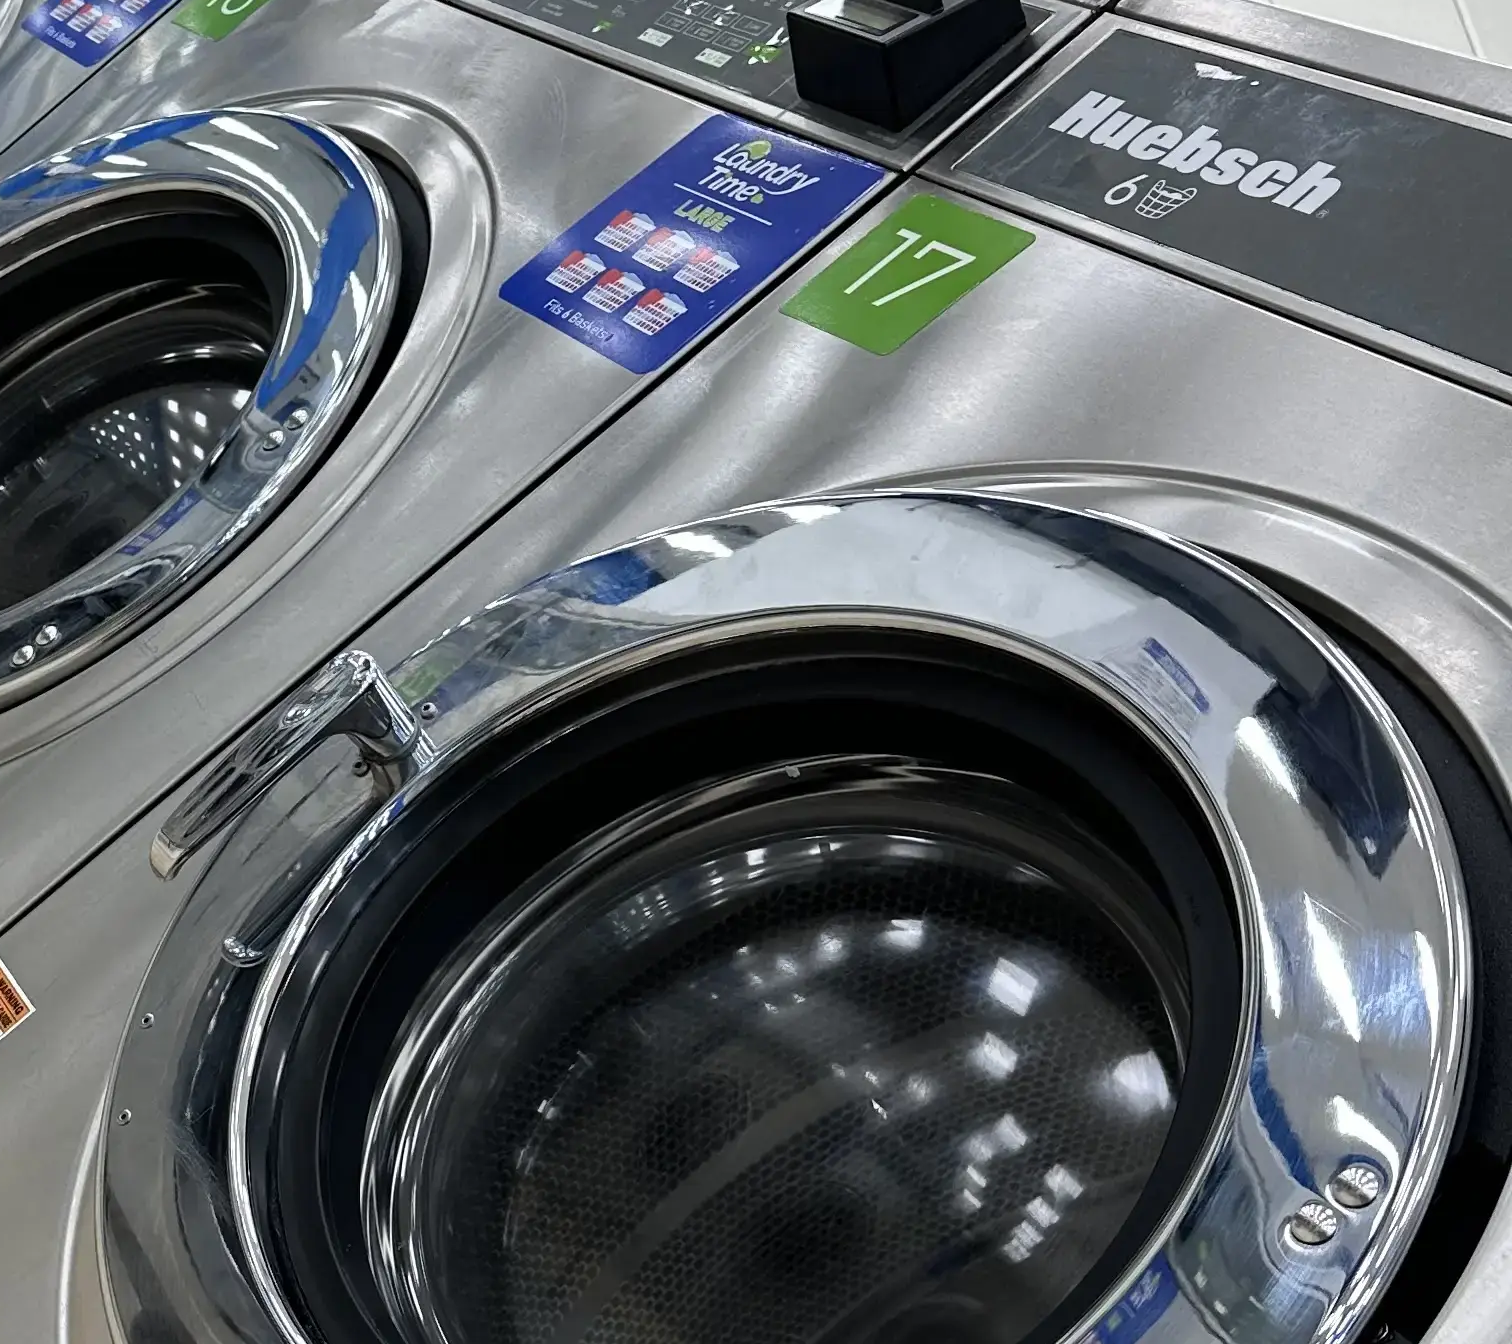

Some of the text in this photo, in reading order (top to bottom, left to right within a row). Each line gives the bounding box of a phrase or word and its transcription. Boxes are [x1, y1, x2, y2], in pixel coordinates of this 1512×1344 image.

[713, 142, 821, 196] Laundry
[1049, 91, 1342, 215] Huebsch
[698, 165, 756, 204] Time
[1103, 173, 1147, 207] 6
[673, 199, 736, 233] LARGE
[843, 228, 977, 307] 17
[542, 297, 563, 317] Fits
[567, 310, 609, 341] Baskets
